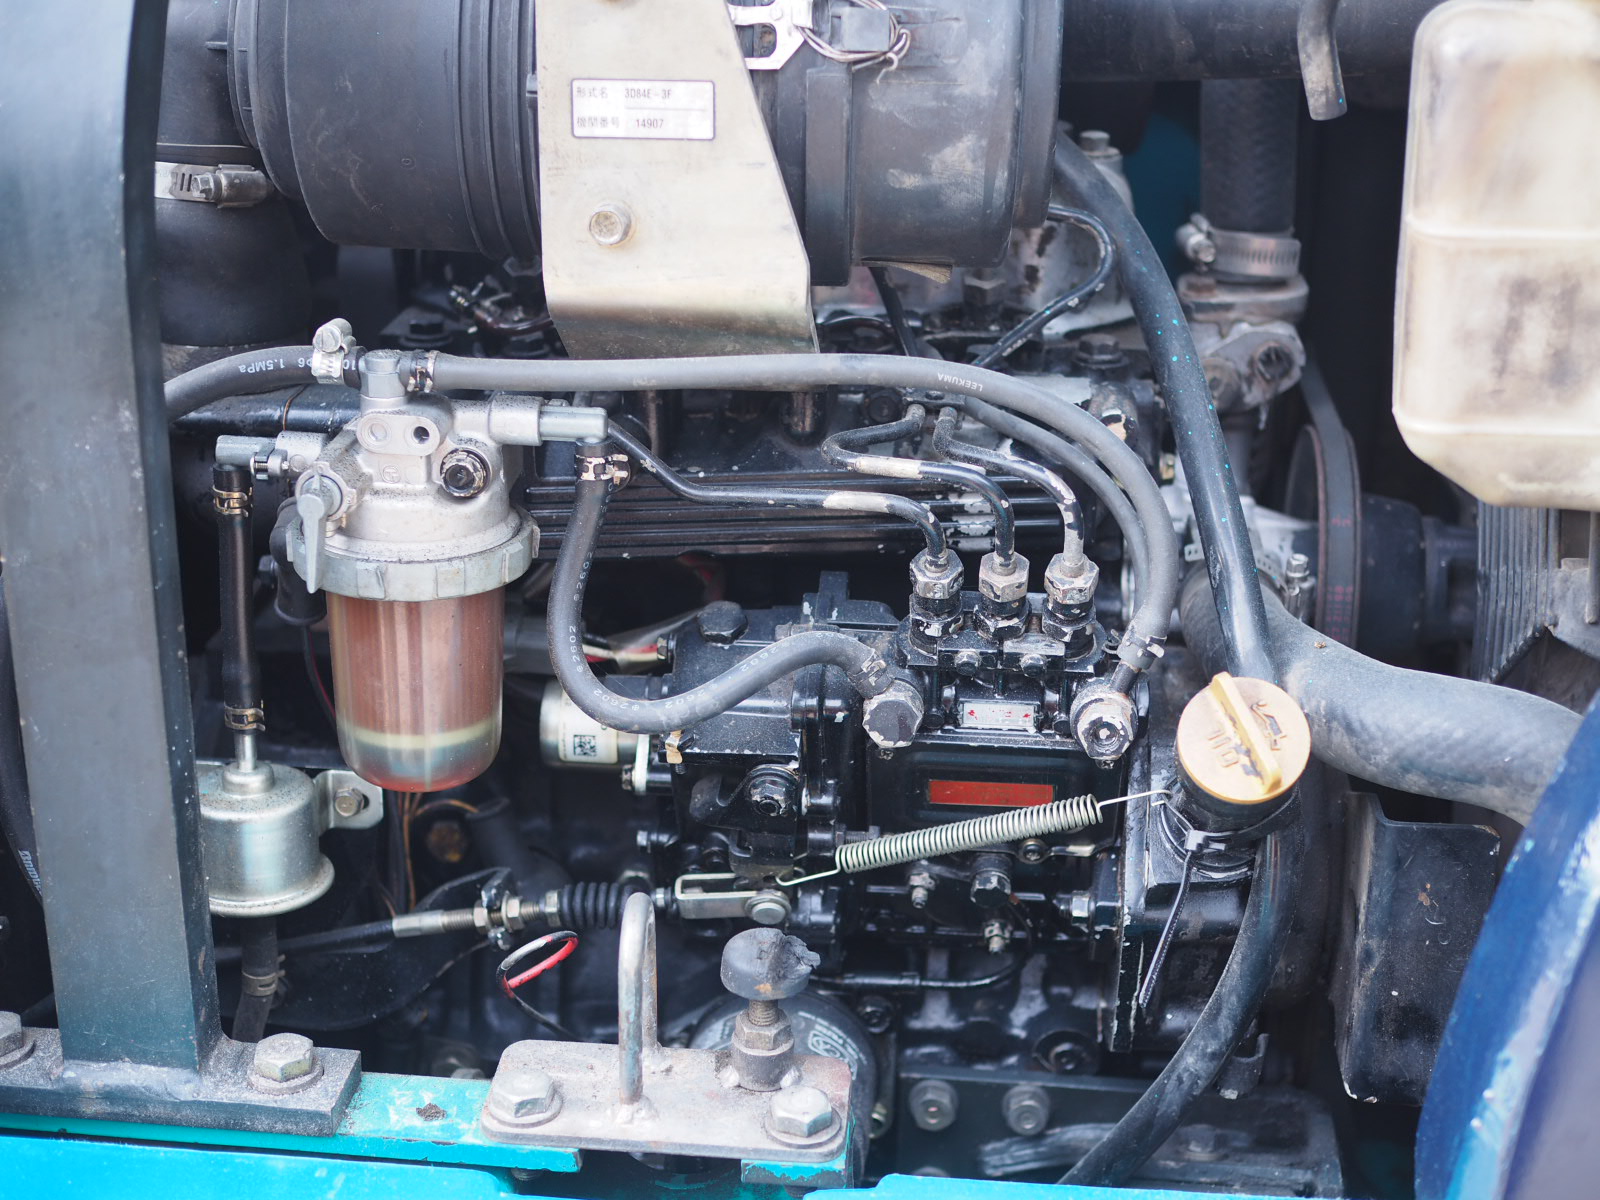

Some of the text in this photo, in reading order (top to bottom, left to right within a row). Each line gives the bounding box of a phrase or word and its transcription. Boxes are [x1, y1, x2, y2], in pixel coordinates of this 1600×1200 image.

[635, 118, 664, 129] 14907
[238, 358, 285, 373] 1.5MPa
[936, 372, 983, 391] LEEKUMA
